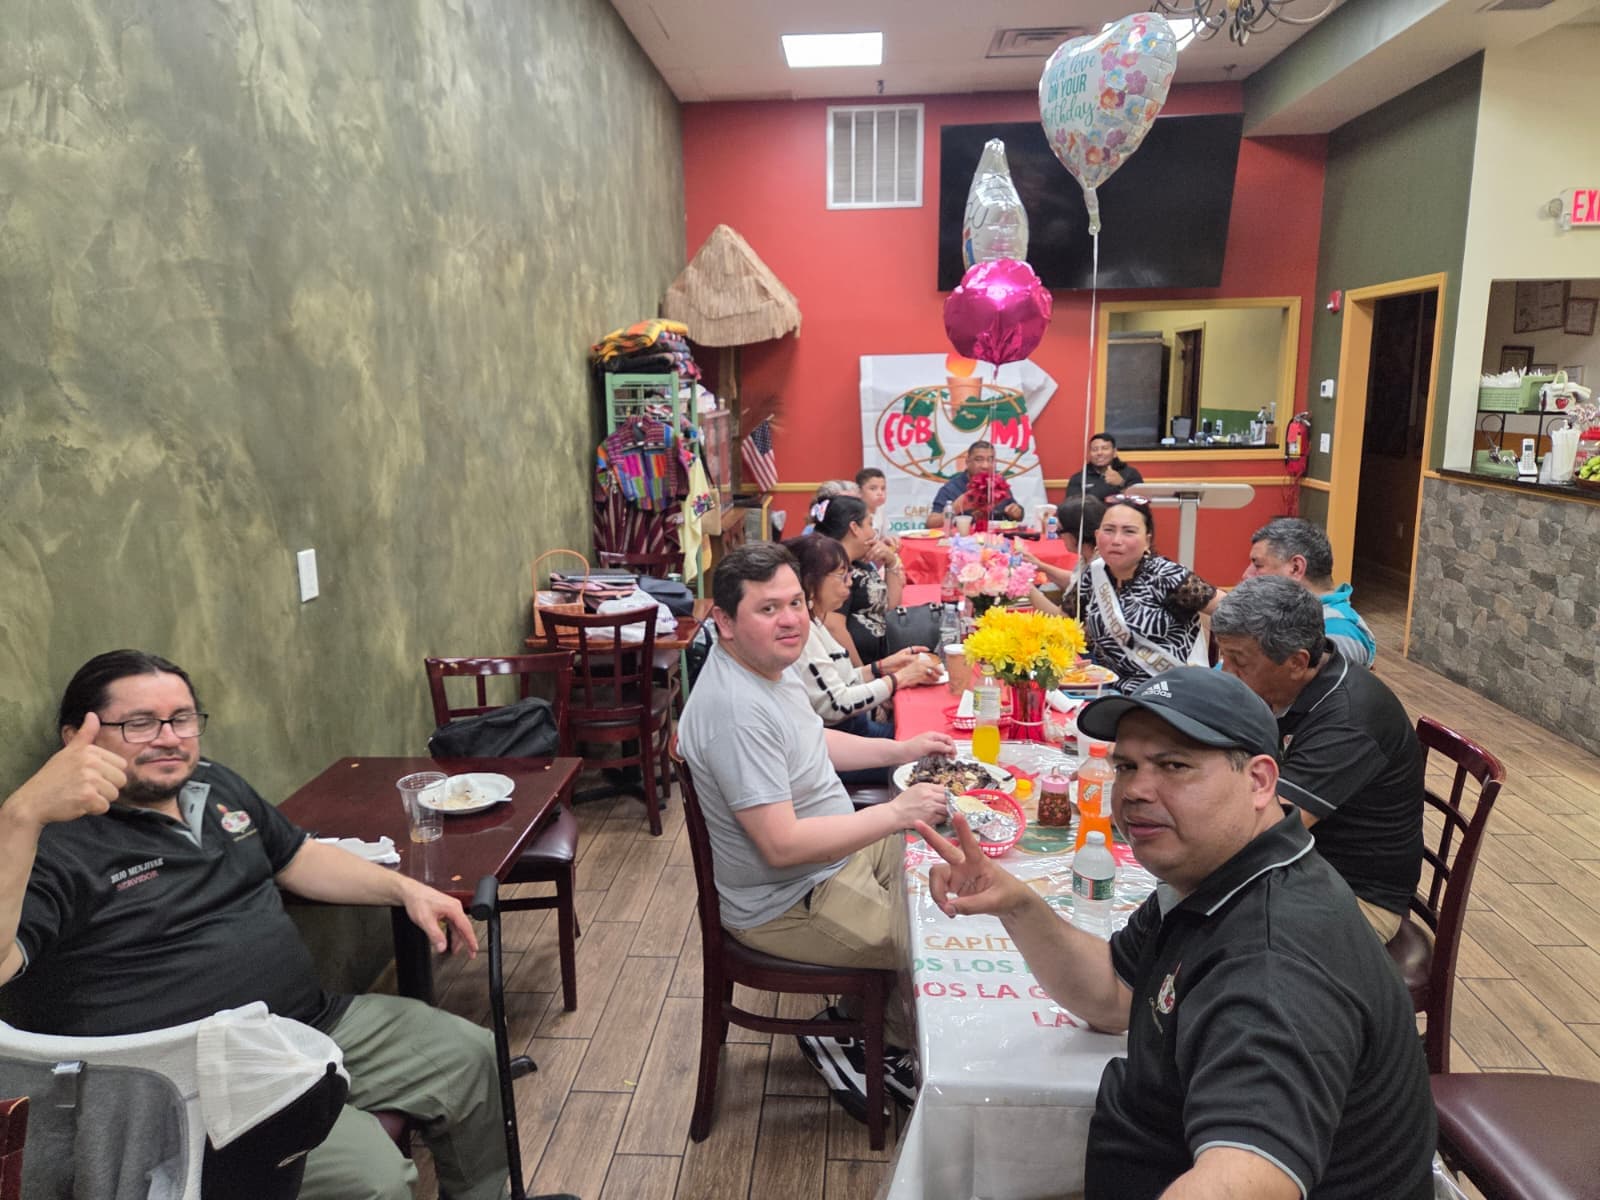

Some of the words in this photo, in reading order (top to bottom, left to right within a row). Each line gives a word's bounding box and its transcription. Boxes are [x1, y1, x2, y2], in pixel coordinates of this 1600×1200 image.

[1061, 73, 1088, 98] YOUR
[883, 411, 933, 453] FGB
[923, 933, 1011, 952] CAPÍT
[953, 958, 1014, 973] LOS
[976, 983, 1020, 999] LA
[1031, 1011, 1080, 1028] LA
